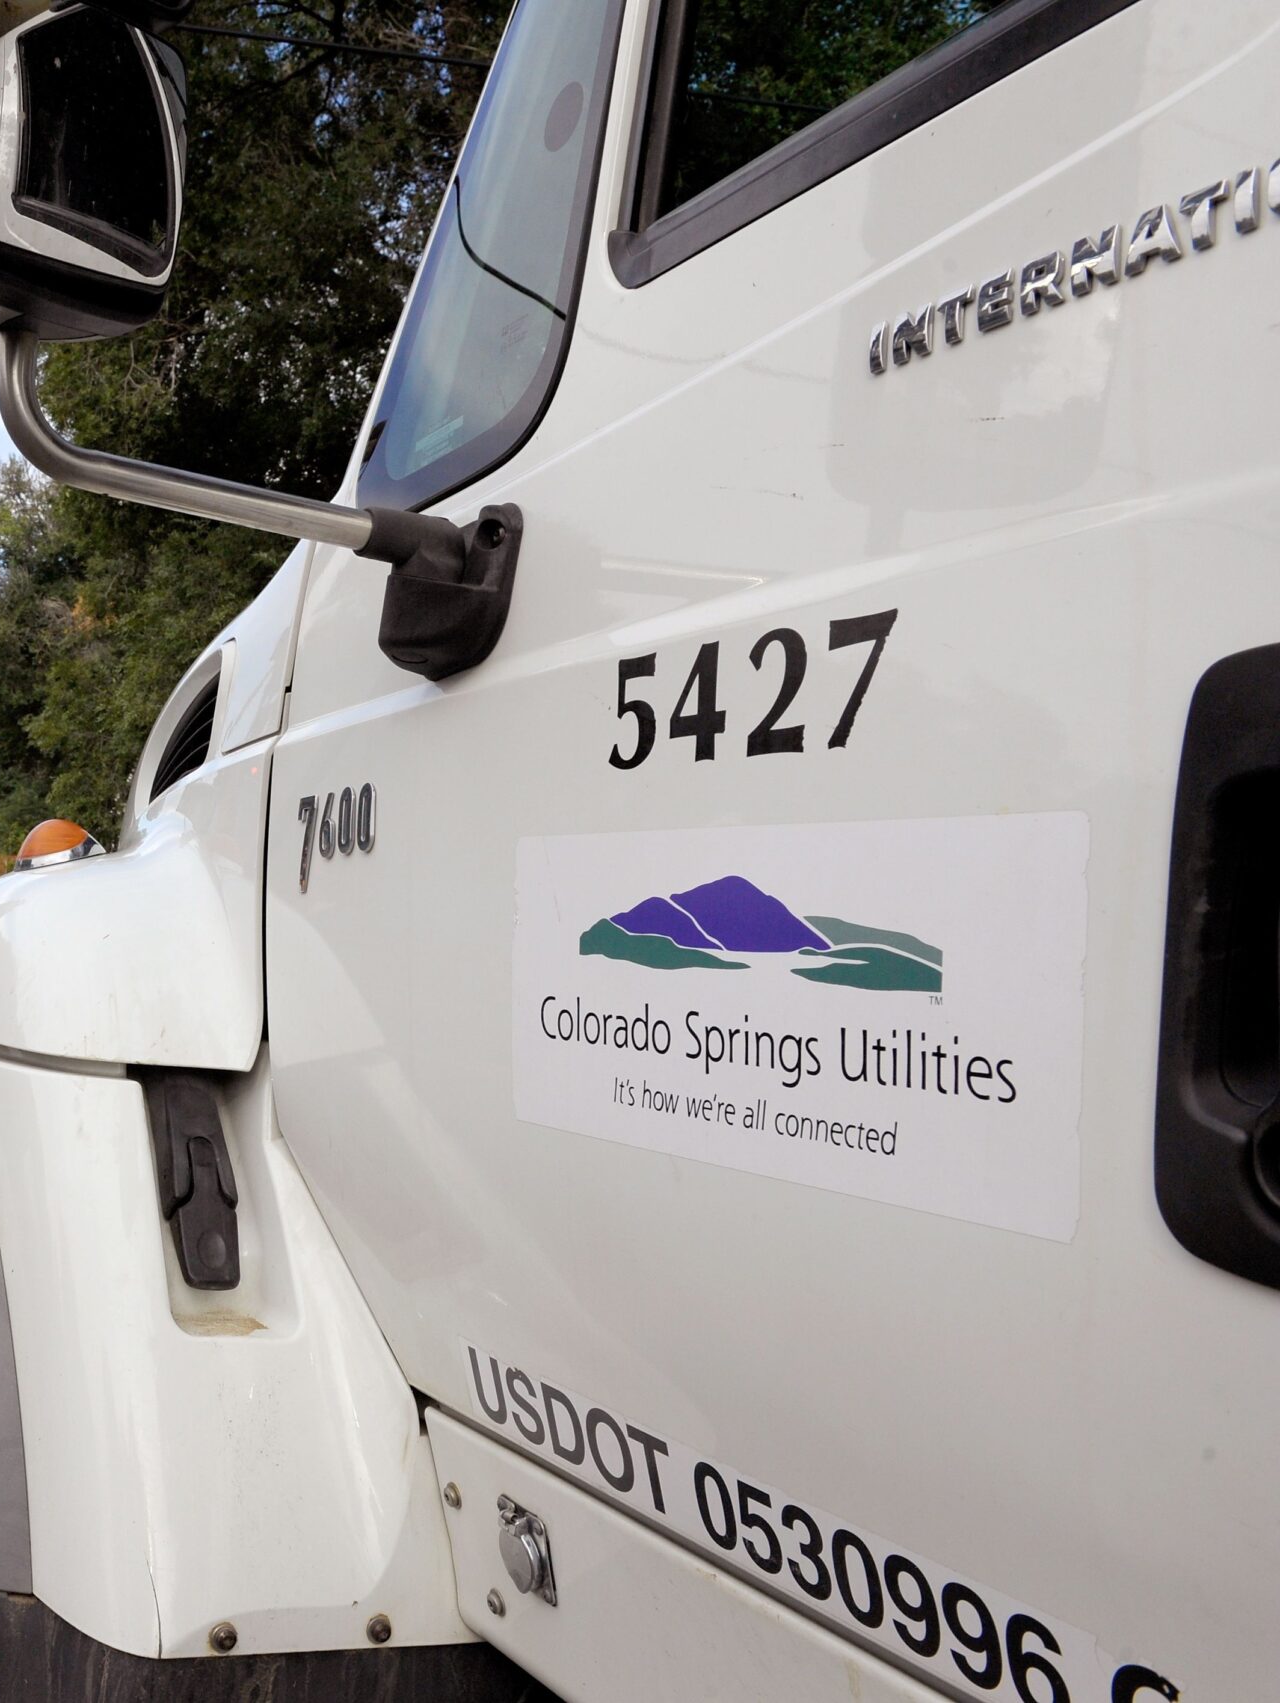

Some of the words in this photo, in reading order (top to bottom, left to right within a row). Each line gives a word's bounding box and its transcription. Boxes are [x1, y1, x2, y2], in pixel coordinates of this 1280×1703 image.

[868, 158, 1280, 376] INTERNATI
[608, 608, 899, 770] 5427
[298, 782, 377, 895] 7600
[540, 995, 672, 1055] Colorado
[685, 1010, 822, 1089] Springs
[840, 1027, 1017, 1104] Utilities
[928, 995, 943, 1006] TM
[613, 1077, 636, 1107] It's
[641, 1079, 680, 1115] how
[686, 1094, 736, 1126] we're
[742, 1098, 767, 1131] all
[774, 1112, 898, 1156] connected
[468, 1346, 669, 1515] USDOT
[693, 1461, 1071, 1703] 0530996
